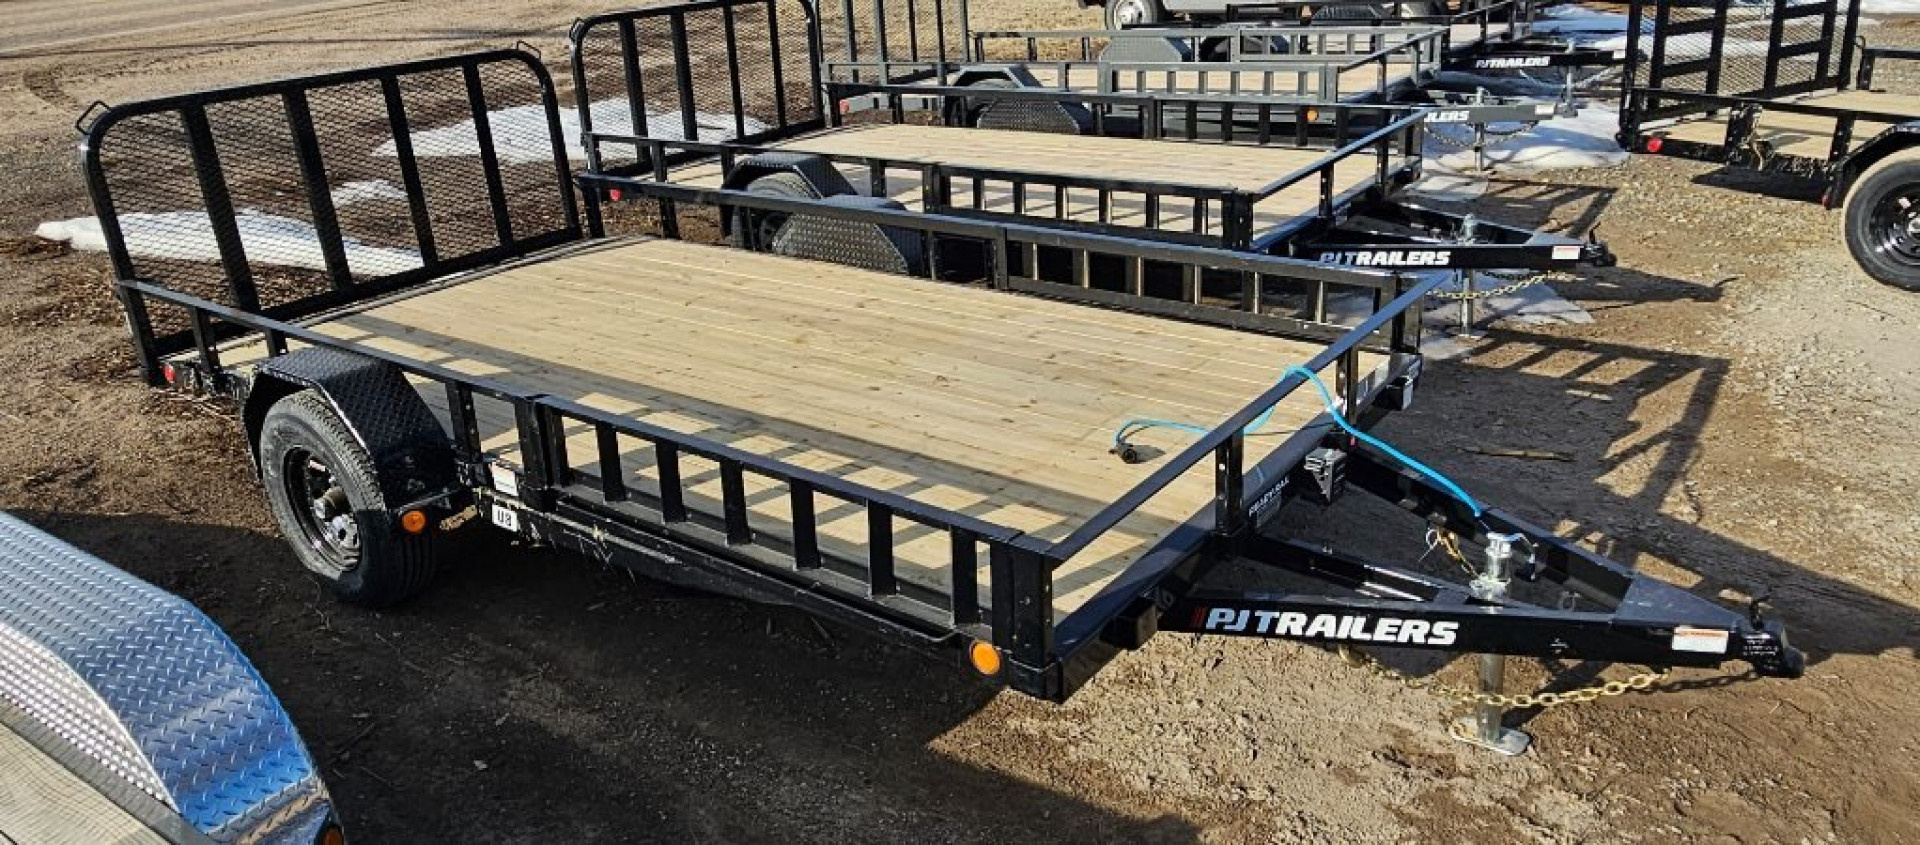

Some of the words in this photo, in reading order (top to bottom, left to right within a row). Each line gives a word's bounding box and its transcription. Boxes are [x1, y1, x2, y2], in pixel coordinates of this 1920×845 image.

[1344, 251, 1451, 266] TRAILERS
[1205, 607, 1250, 632] PJ
[1253, 610, 1459, 646] TRAILERS
